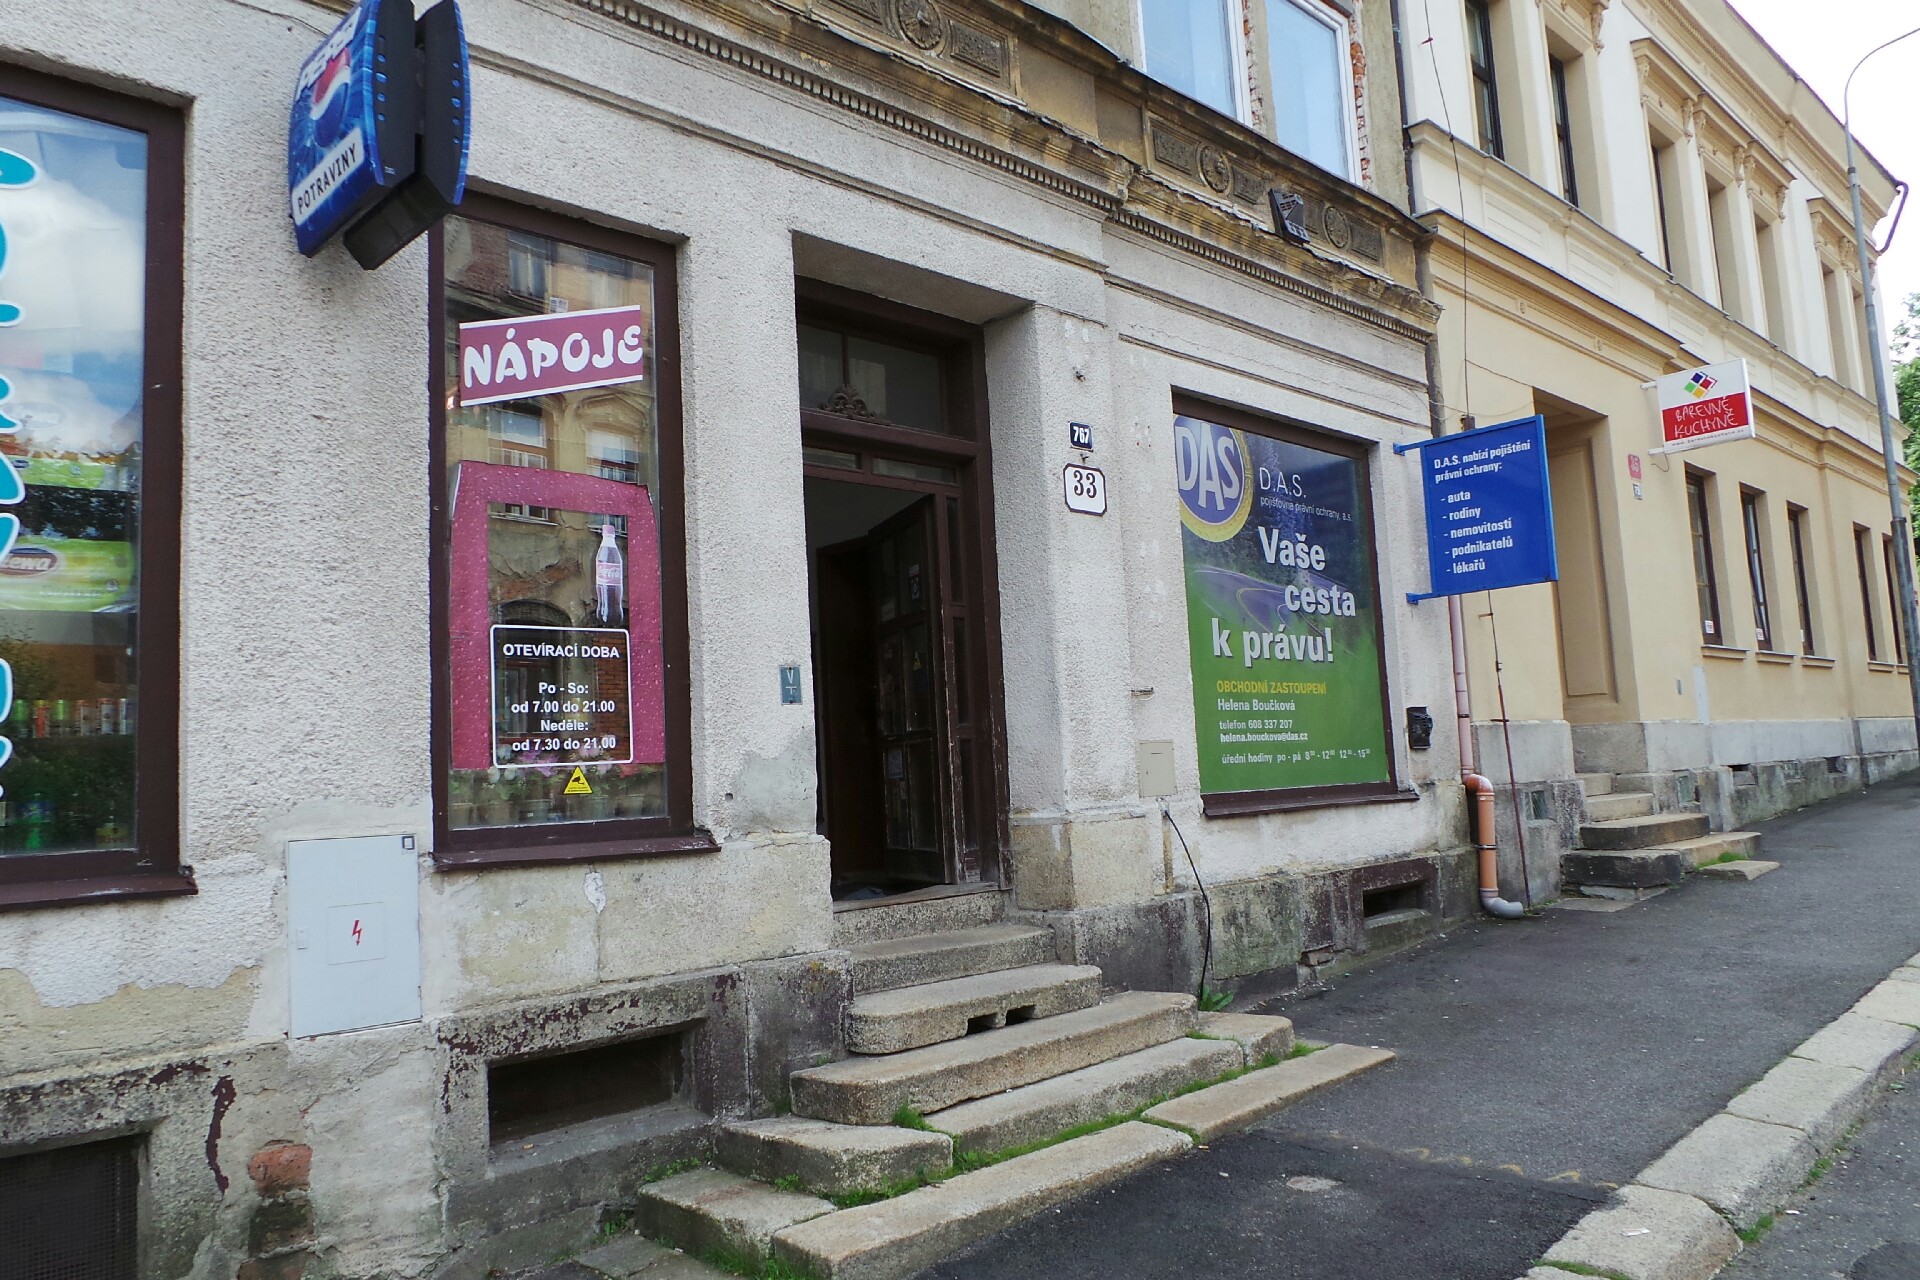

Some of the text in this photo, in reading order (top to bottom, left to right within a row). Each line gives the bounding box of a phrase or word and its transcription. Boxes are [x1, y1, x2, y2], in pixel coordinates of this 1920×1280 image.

[297, 142, 356, 215] POTRAVINY
[463, 325, 643, 388] NÁPOJE
[1675, 396, 1730, 422] BAREVNÉ
[1674, 408, 1739, 439] KUCHYNĚ
[1073, 426, 1090, 444] 767
[1434, 440, 1531, 469] D.A.S. nabízí pojištění
[1175, 421, 1240, 511] DAS
[1435, 462, 1502, 484] právní ochrany:
[1073, 470, 1098, 499] 33
[1259, 467, 1308, 499] D.A.S.
[1447, 491, 1471, 504] auta
[1449, 506, 1481, 521] rodiny
[1450, 517, 1512, 539] nemovitostí
[1258, 525, 1326, 571] Vaše
[1452, 536, 1514, 558] podnikatelů
[4, 556, 52, 570] ewa
[1453, 558, 1486, 574] lékařů
[1284, 584, 1356, 617] cesta
[502, 642, 620, 658] OTEVÍRACÍ DOBA
[1211, 617, 1334, 668] k právu!
[538, 682, 556, 694] Po
[567, 682, 589, 694] So:
[1216, 679, 1327, 694] OBCHODNÍ ZASTOUPENÍ
[511, 700, 615, 713] od 7.00 do 21.00
[1217, 698, 1295, 711] Helena Boučková
[540, 719, 589, 732] Neděle:
[1219, 719, 1293, 730] telefon 608 337 207
[512, 737, 616, 751] od 7.30 do 21.00
[1220, 732, 1309, 743] helena.bouckova@das.cz
[1247, 752, 1273, 764] hodiny
[1277, 754, 1286, 764] po
[1292, 751, 1302, 763] pá
